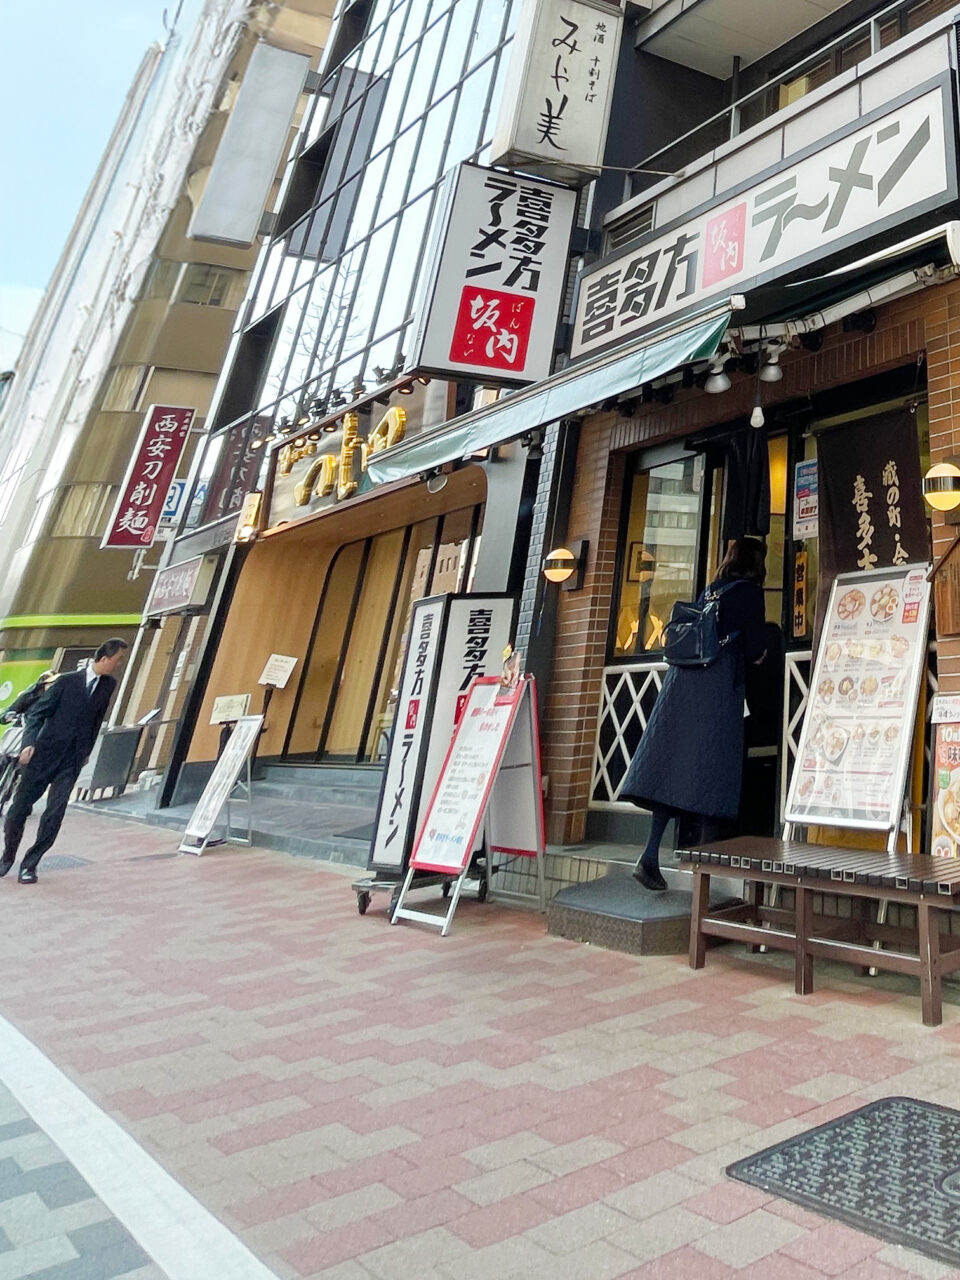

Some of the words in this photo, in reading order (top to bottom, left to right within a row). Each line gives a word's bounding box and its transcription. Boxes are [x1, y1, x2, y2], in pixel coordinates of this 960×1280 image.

[536, 15, 583, 151] みや美
[465, 176, 517, 278] ラーメン
[502, 186, 554, 292] 喜多方
[751, 114, 931, 263] ラーメン
[469, 294, 519, 364] 坂内
[509, 302, 524, 329] ばん
[581, 231, 701, 345] 喜多方
[410, 613, 434, 696] 喜多方
[384, 733, 414, 848] ラーメン
